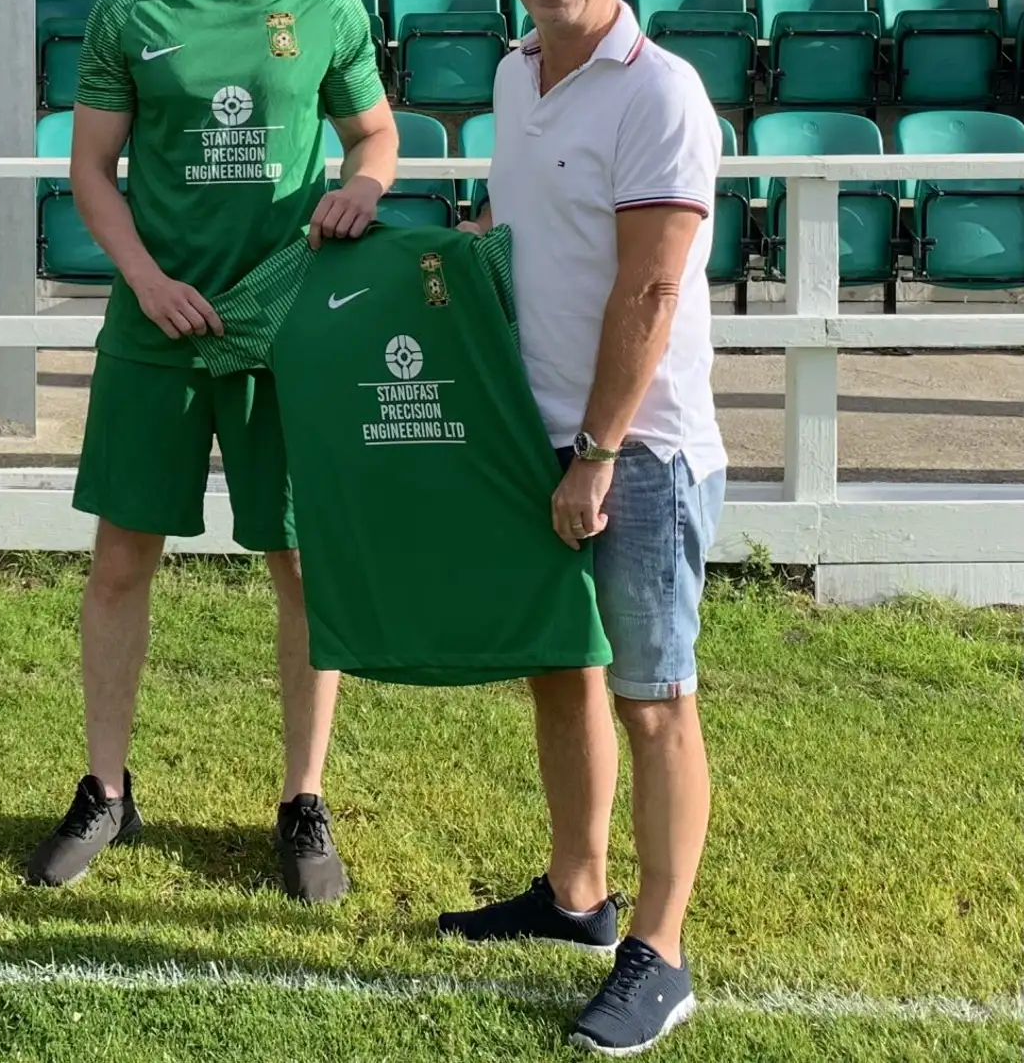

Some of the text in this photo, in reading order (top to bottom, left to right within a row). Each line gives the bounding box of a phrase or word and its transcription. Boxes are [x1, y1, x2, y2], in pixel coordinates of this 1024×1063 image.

[201, 130, 266, 146] STANDFAST
[204, 147, 265, 162] PRECISION
[185, 163, 282, 180] ENGINEERING LTD
[377, 384, 439, 402] STANDFAST
[381, 403, 442, 420] PRECISION
[363, 422, 465, 440] ENGINEERING LTD
